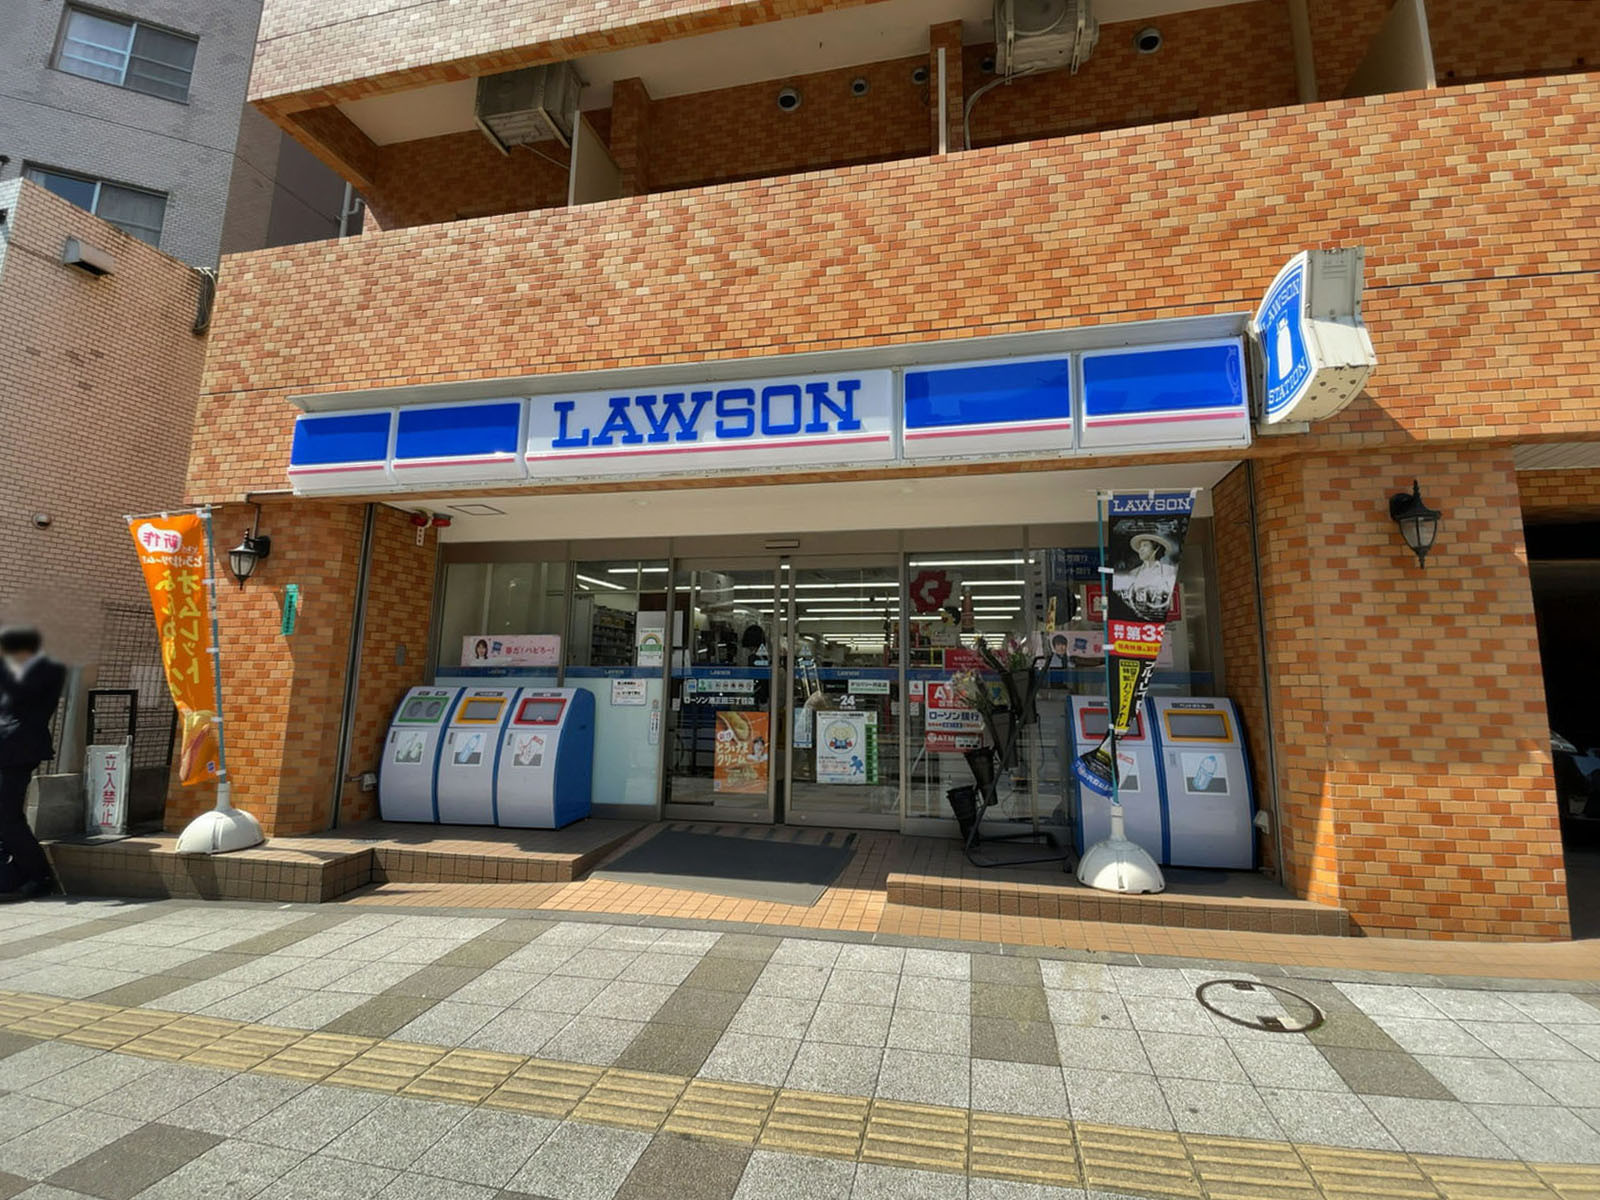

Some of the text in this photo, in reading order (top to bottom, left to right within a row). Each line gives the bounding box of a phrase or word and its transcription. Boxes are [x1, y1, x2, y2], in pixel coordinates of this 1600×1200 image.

[1262, 278, 1300, 330] LAWSON
[1268, 356, 1307, 404] STATION
[552, 379, 861, 448] LAWSON
[1113, 498, 1191, 512] LAWSON
[840, 695, 856, 706] 24
[929, 711, 980, 721] ローソン銀行
[99, 754, 118, 829] 立入禁止
